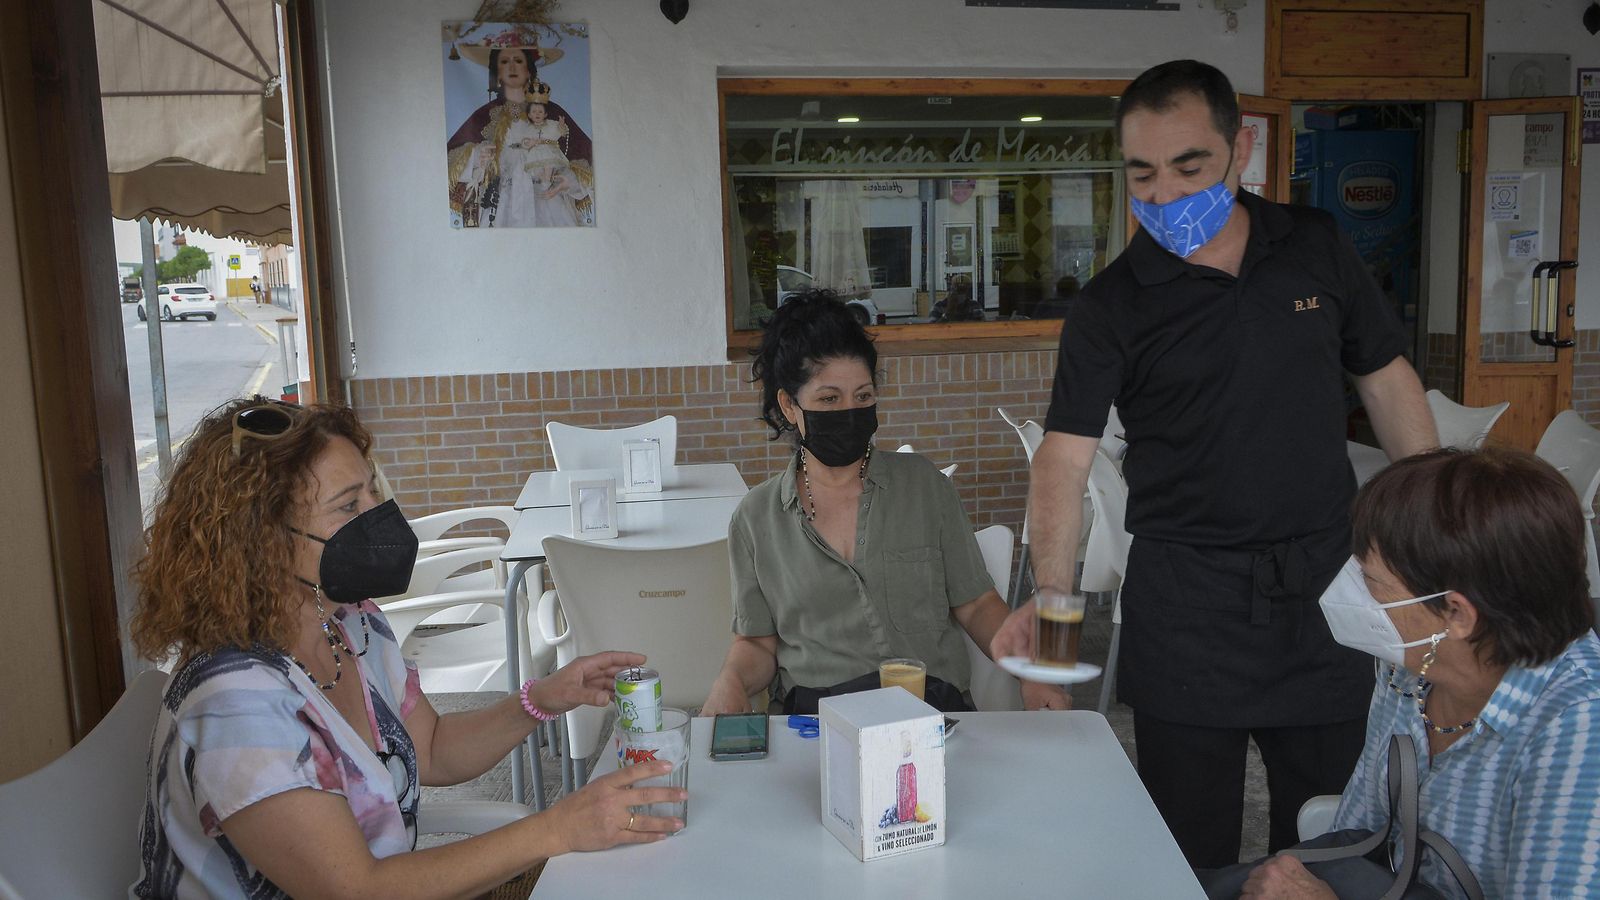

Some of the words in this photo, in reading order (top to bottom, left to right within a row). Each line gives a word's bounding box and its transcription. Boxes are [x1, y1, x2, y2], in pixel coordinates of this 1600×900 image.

[822, 134, 937, 164] rincón
[949, 128, 982, 164] de
[997, 127, 1092, 163] María
[639, 589, 686, 598] Cruzcampo
[625, 747, 660, 764] MAX
[881, 841, 895, 851] VINO
[895, 832, 935, 848] SELECCIONADO
[882, 831, 896, 841] ZUMO
[896, 827, 917, 839] NATURAL
